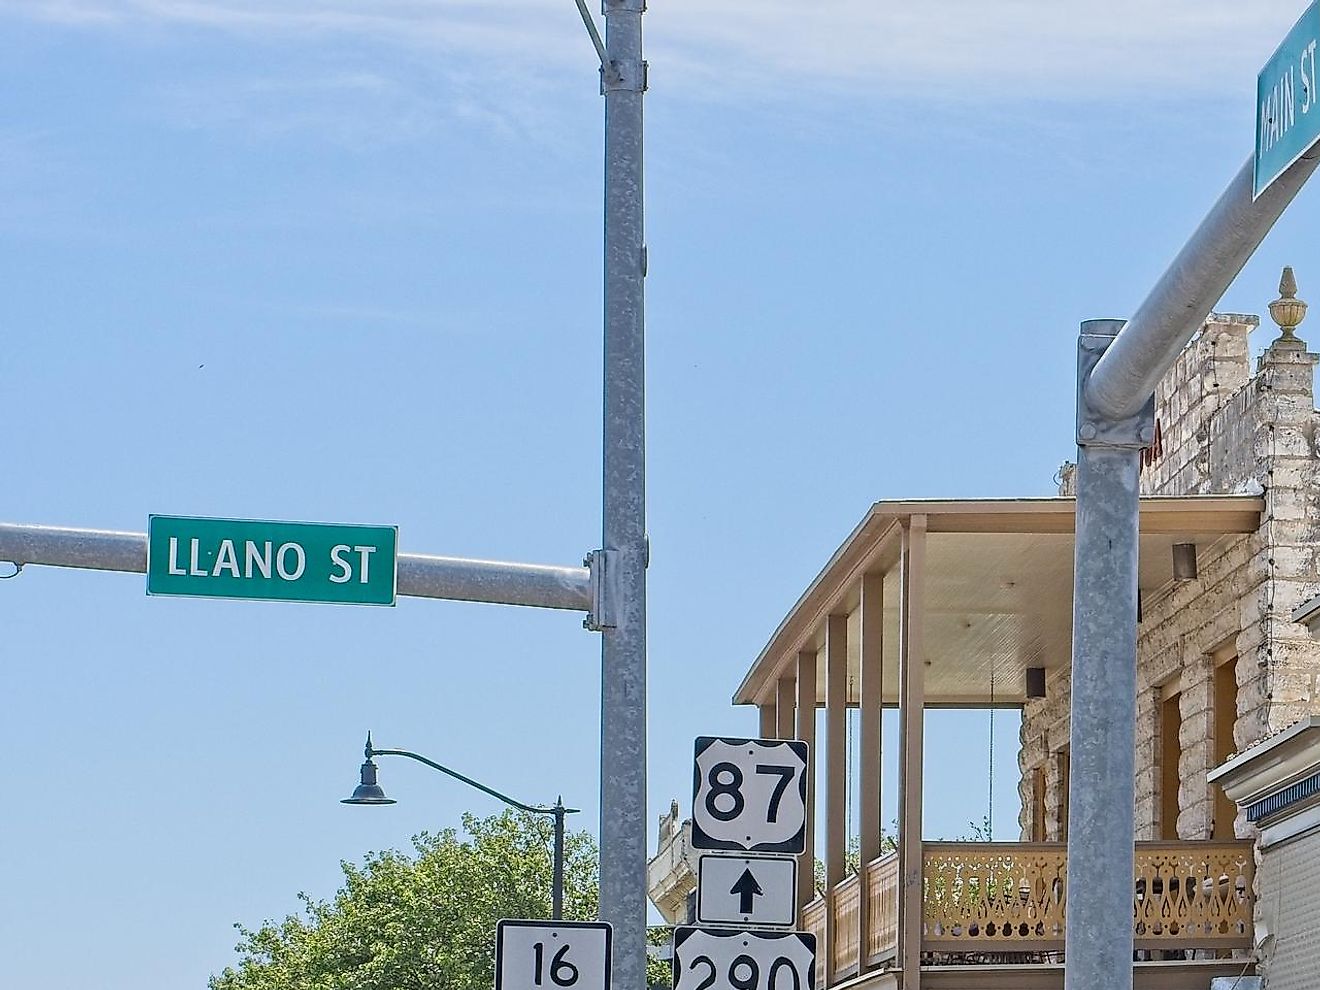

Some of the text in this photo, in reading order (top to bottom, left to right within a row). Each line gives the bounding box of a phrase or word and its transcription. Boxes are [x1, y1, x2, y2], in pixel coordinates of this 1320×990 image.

[1259, 39, 1317, 160] MAIN ST
[168, 537, 377, 584] LLANO ST
[705, 762, 796, 823] 87
[533, 942, 579, 987] 16
